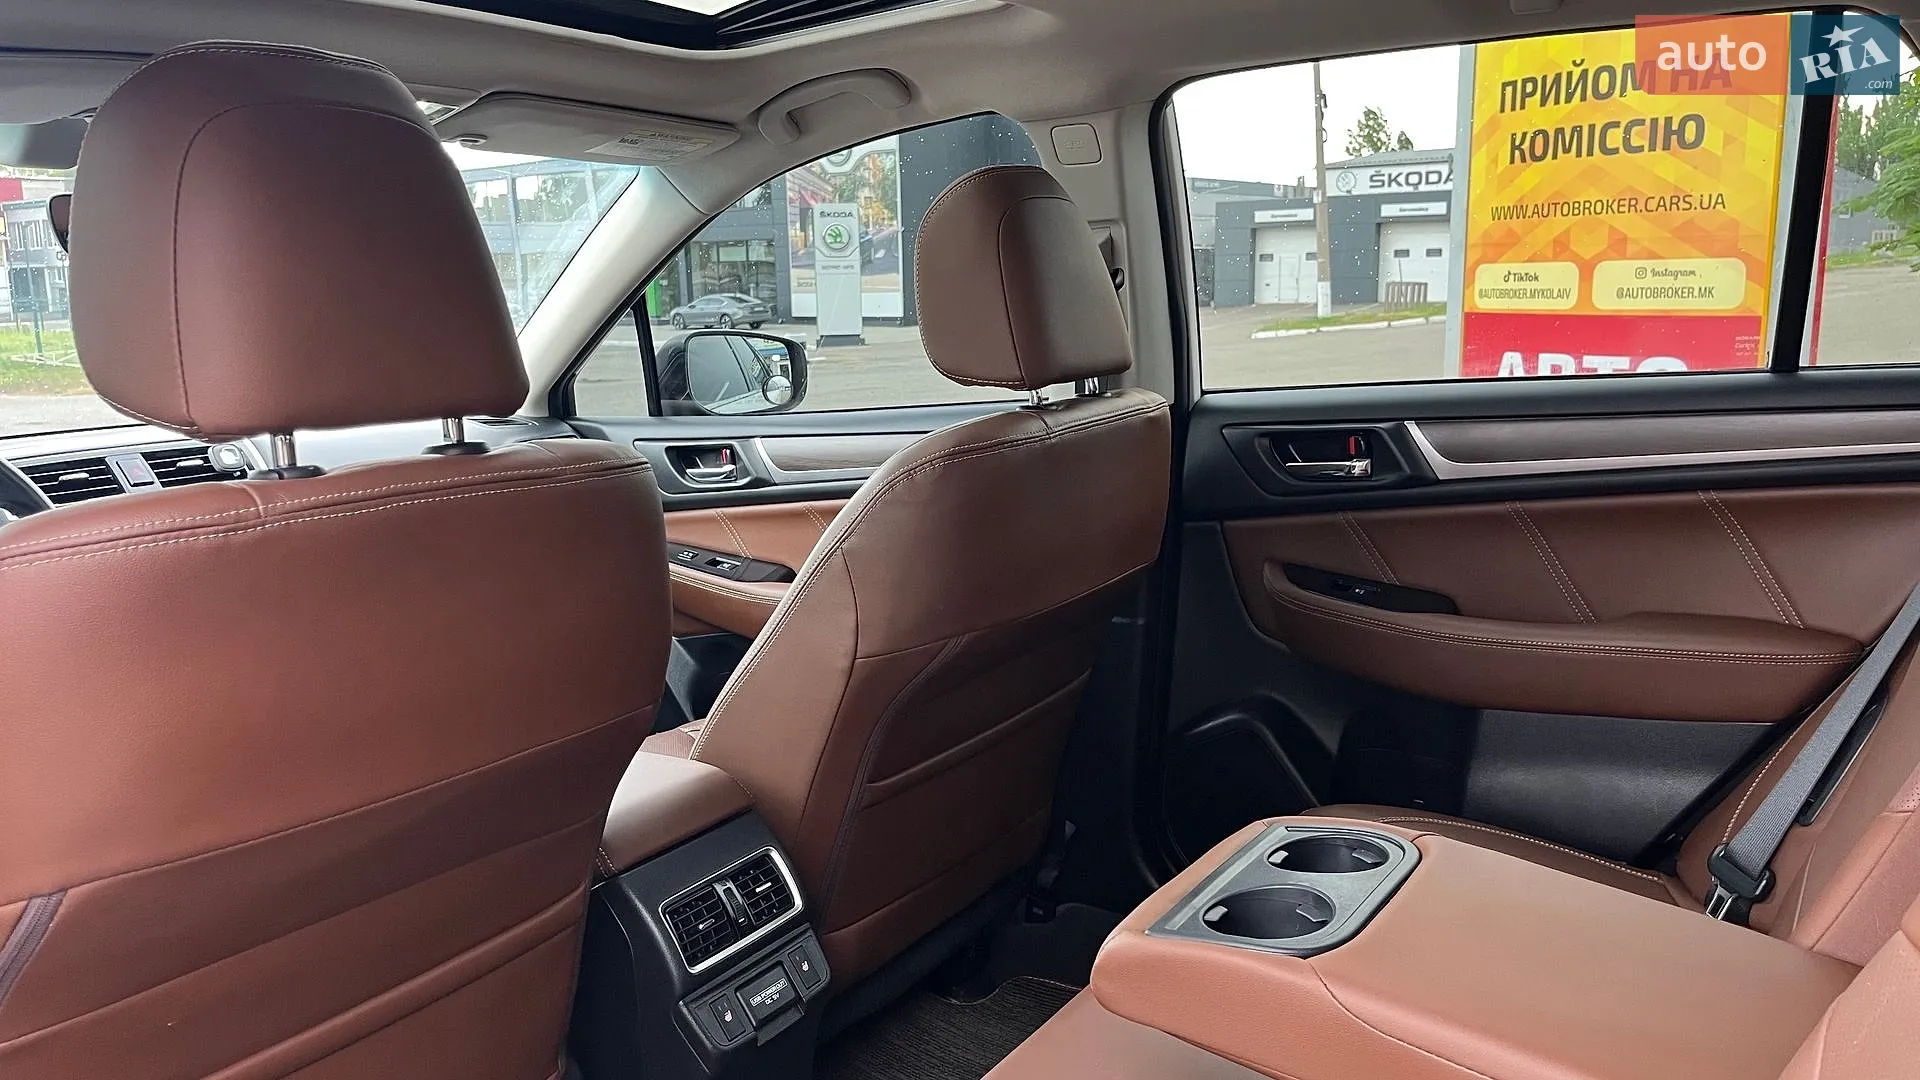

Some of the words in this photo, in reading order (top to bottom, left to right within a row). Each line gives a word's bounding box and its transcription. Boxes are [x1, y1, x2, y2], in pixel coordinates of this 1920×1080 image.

[1499, 58, 1657, 114] ПРИЙОМ
[1509, 113, 1706, 165] КОМІССІЮ
[1490, 193, 1726, 221] WWW.AUTOBROKER.CARS.UA
[1512, 272, 1540, 282] TikTok
[1650, 267, 1696, 280] Instagram
[1616, 286, 1715, 299] @AUTOBROKER.MK
